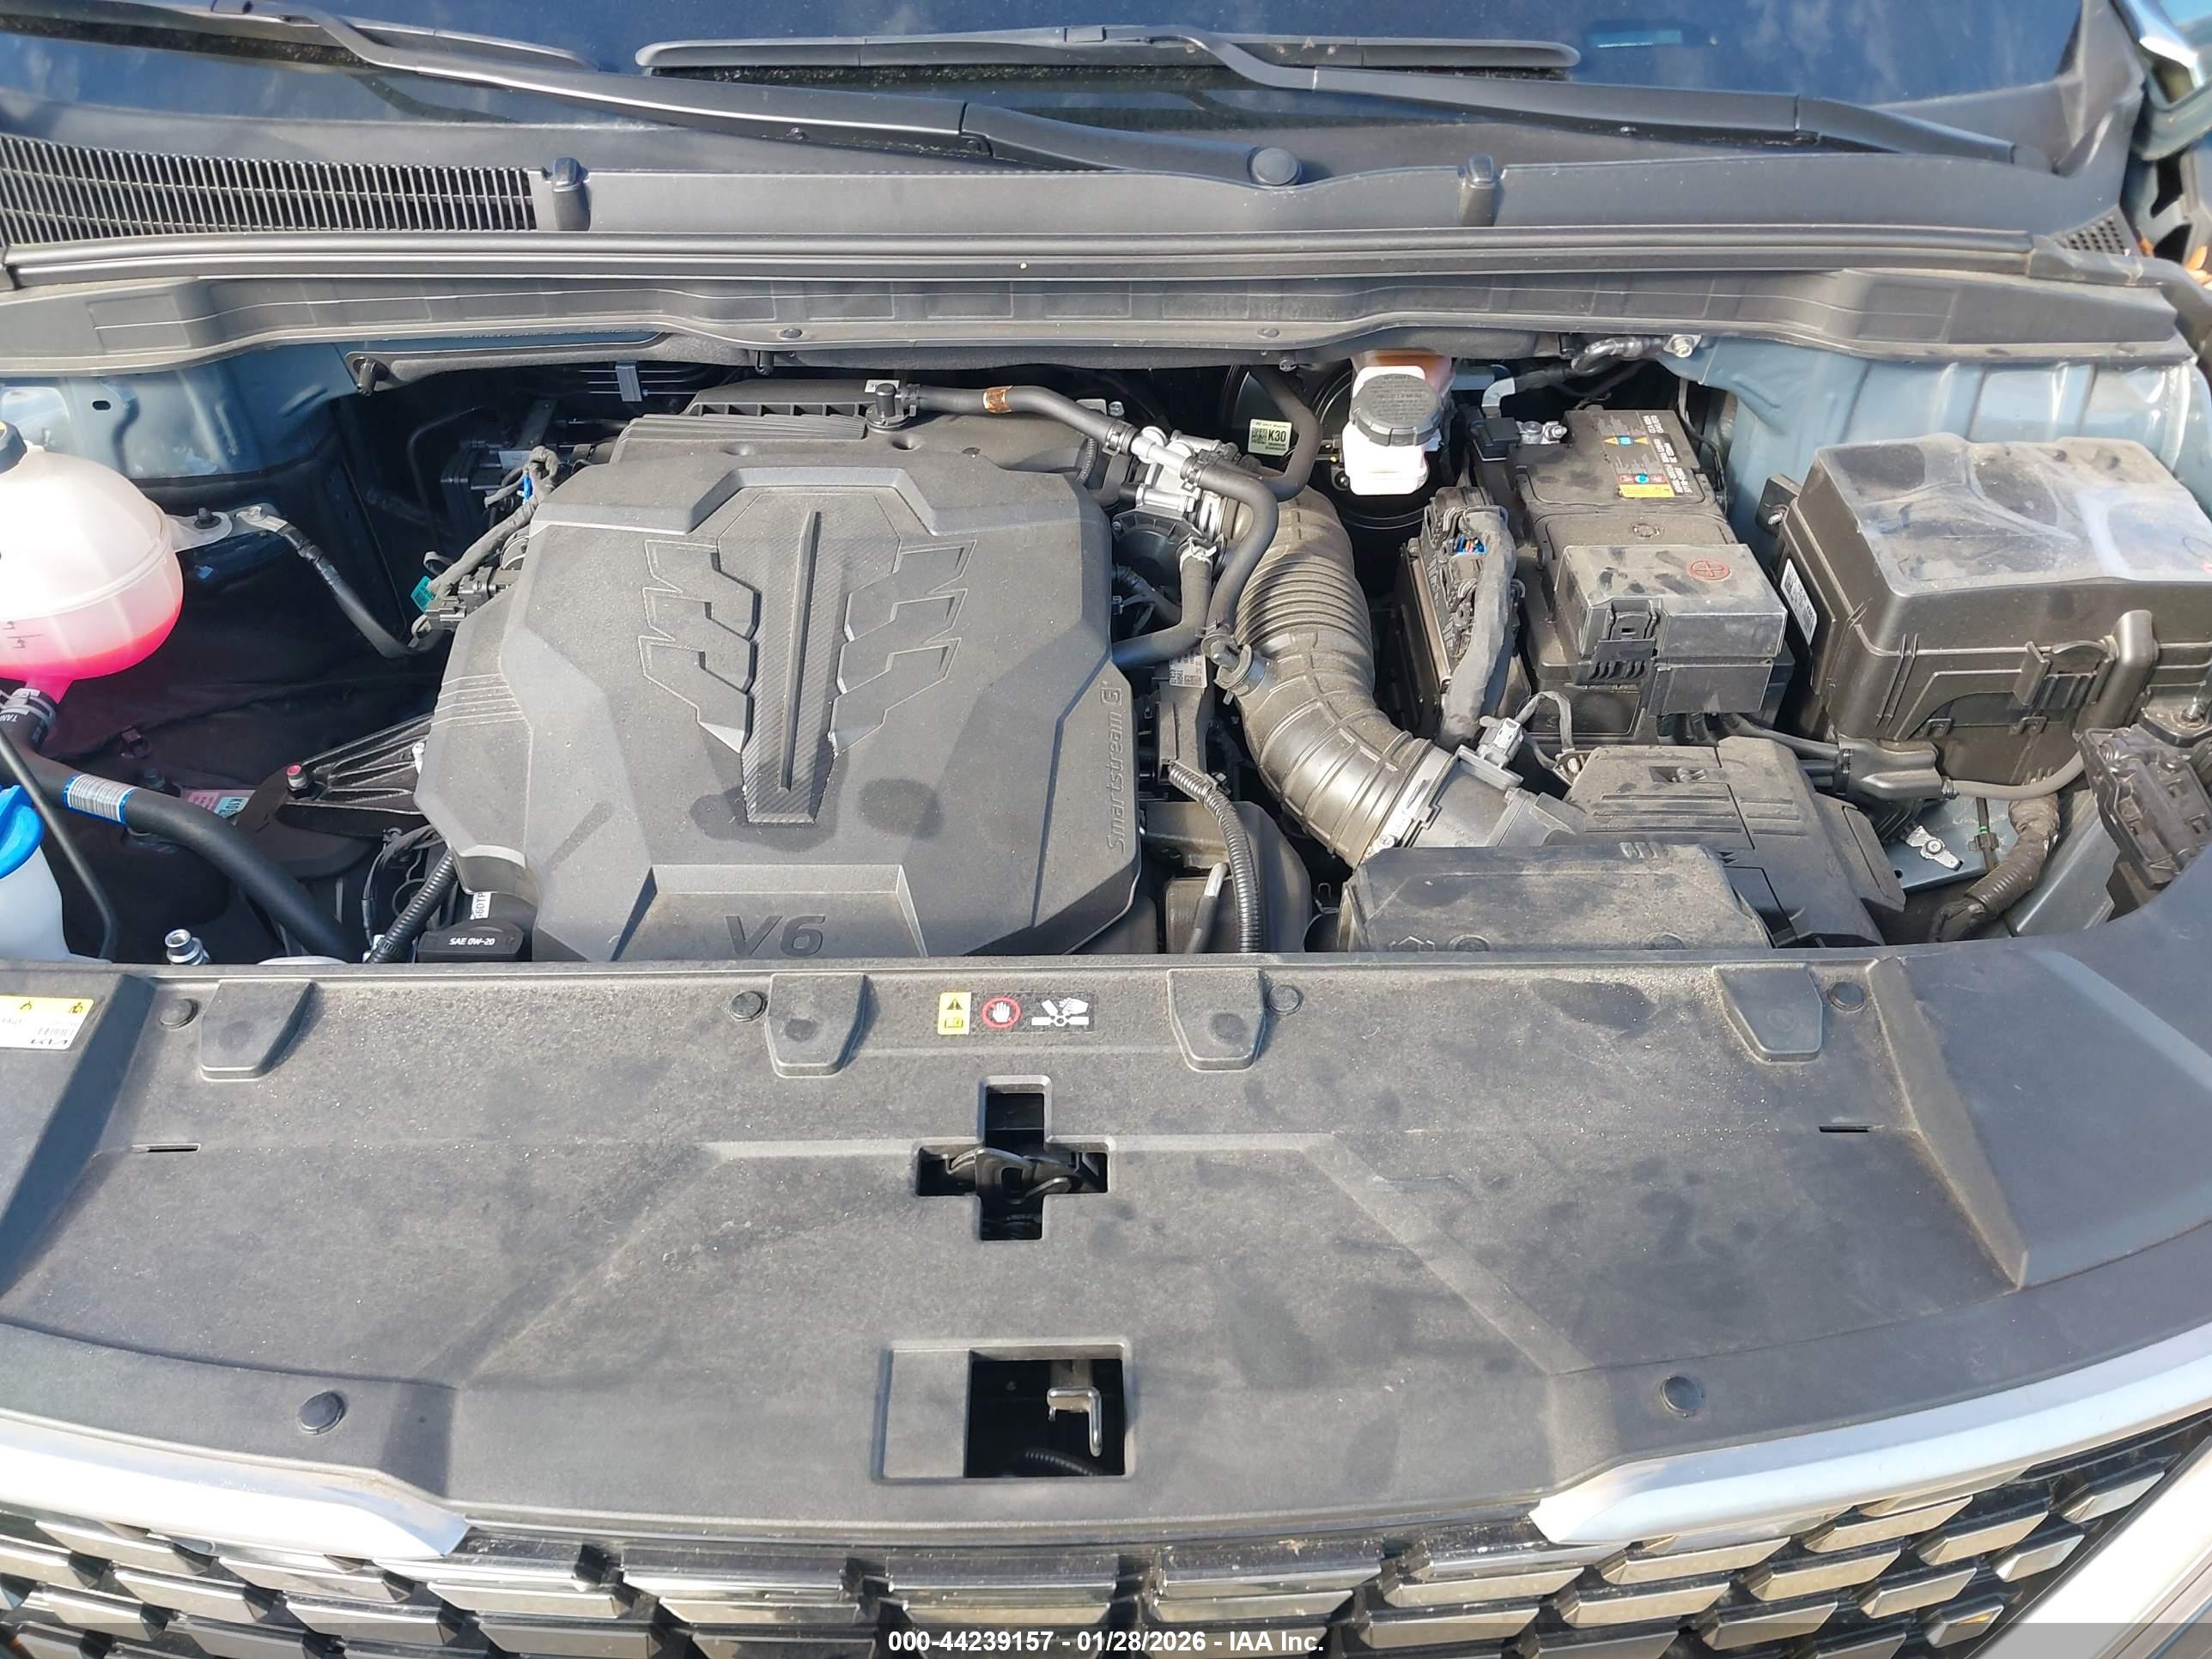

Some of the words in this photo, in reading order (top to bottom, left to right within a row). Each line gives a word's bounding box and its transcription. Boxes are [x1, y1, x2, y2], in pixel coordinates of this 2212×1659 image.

[1267, 429, 1286, 442] K30
[1107, 712, 1126, 853] Smartstream
[448, 937, 467, 945] SAE
[467, 937, 495, 945] 0W-20
[726, 915, 825, 957] V6
